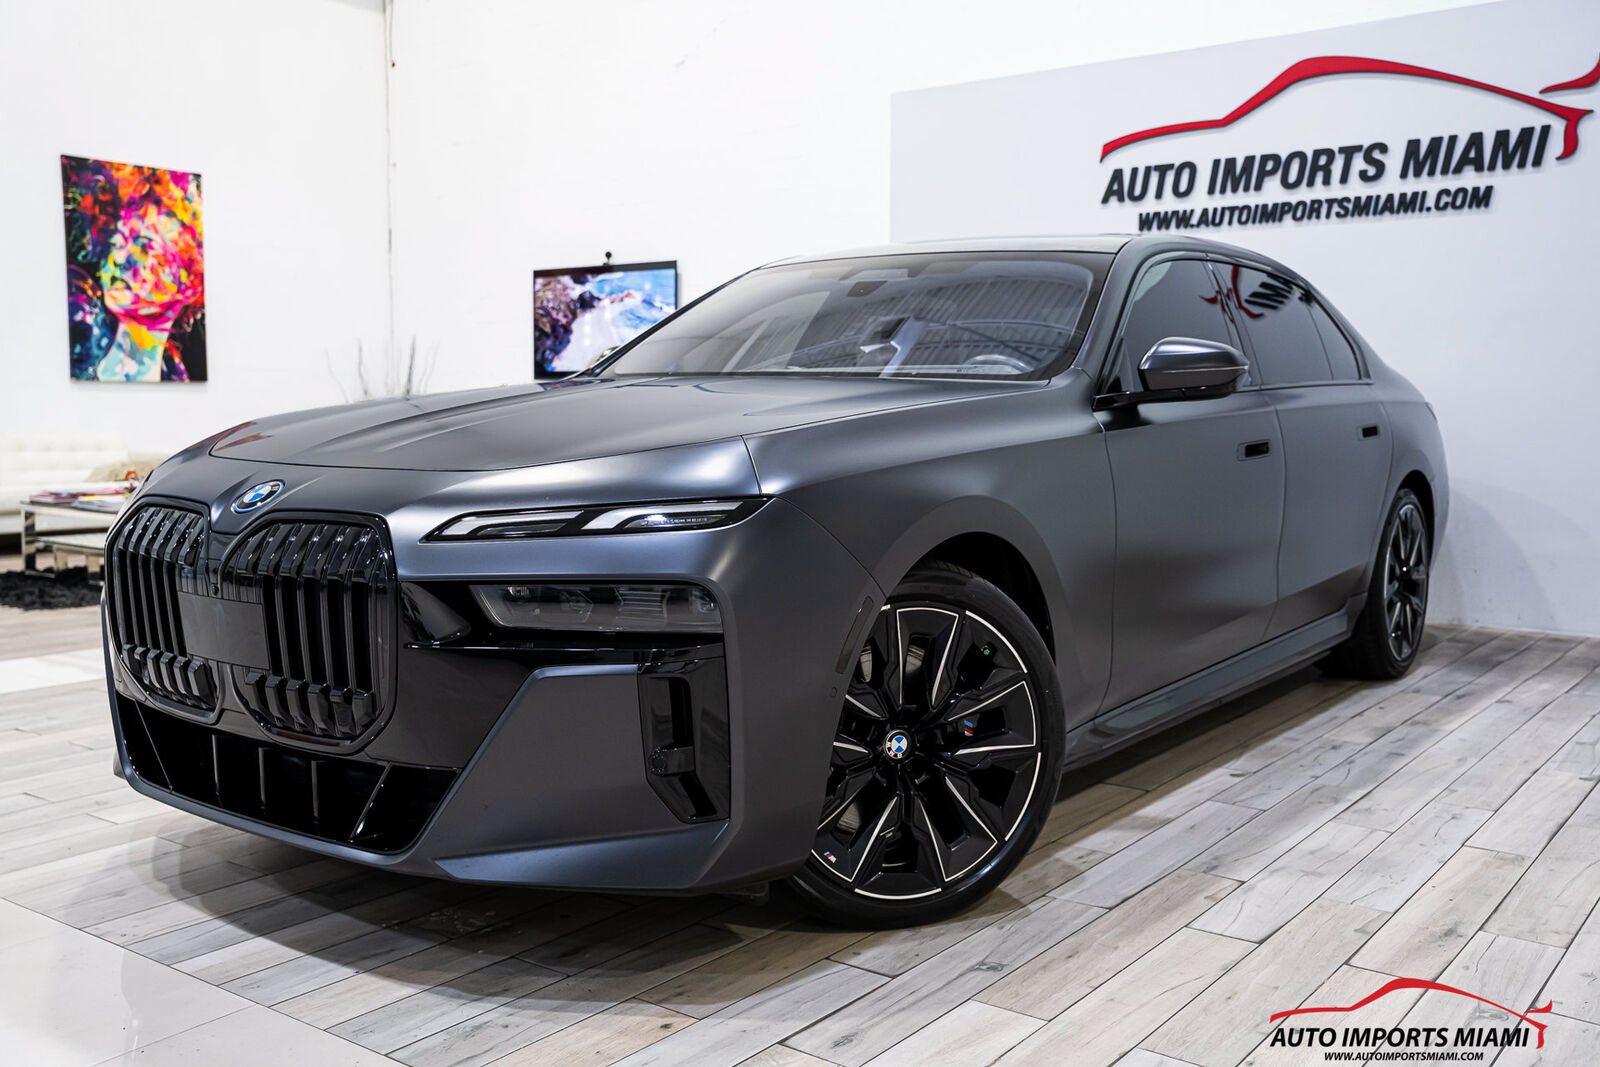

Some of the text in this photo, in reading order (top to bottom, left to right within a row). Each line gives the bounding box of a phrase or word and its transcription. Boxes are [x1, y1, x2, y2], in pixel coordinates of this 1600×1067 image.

[1101, 124, 1552, 205] AUTO IMPORTS MIAMI
[1138, 185, 1494, 232] WWW.AUTOIMPORTSMIAMI.COM
